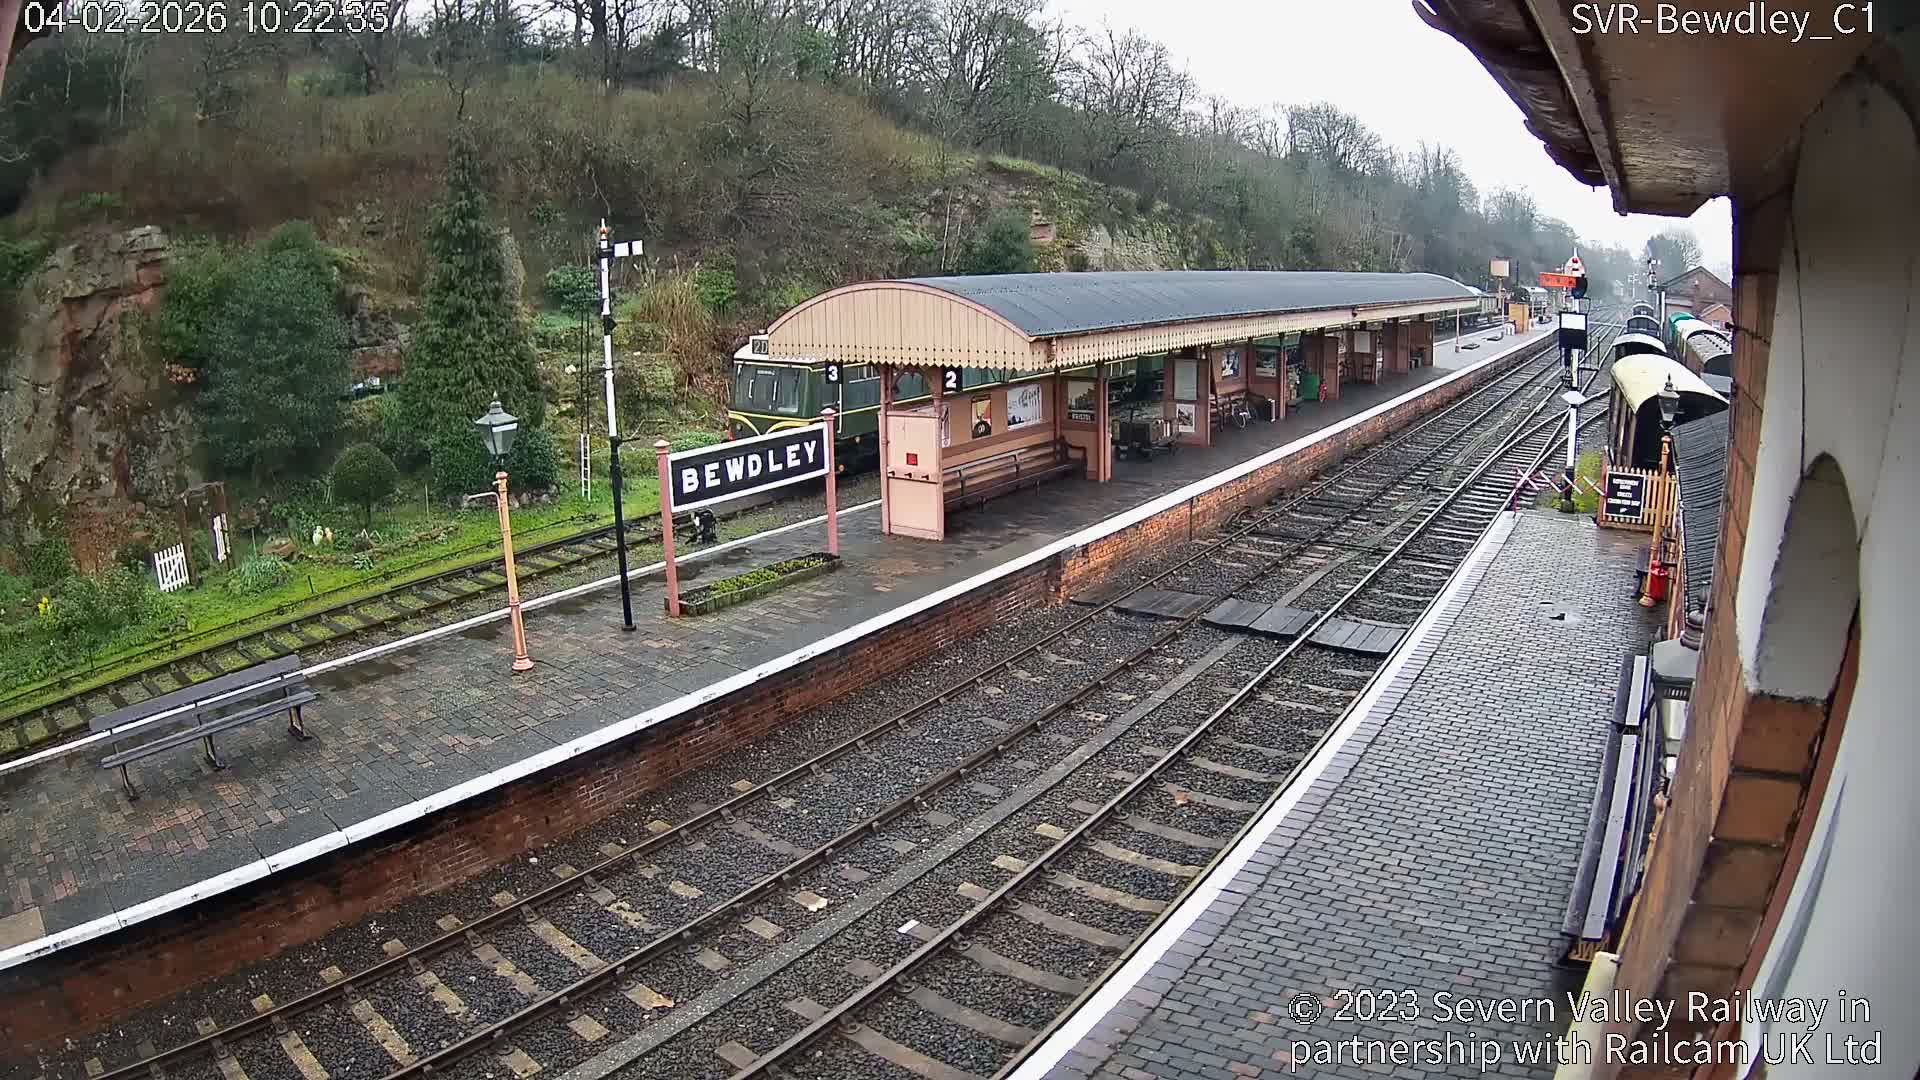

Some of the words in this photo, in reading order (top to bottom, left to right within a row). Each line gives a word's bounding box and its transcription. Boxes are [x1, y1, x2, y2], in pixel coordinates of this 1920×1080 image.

[828, 365, 838, 381] 3
[945, 370, 957, 388] 2
[681, 440, 817, 494] BEWDLEY
